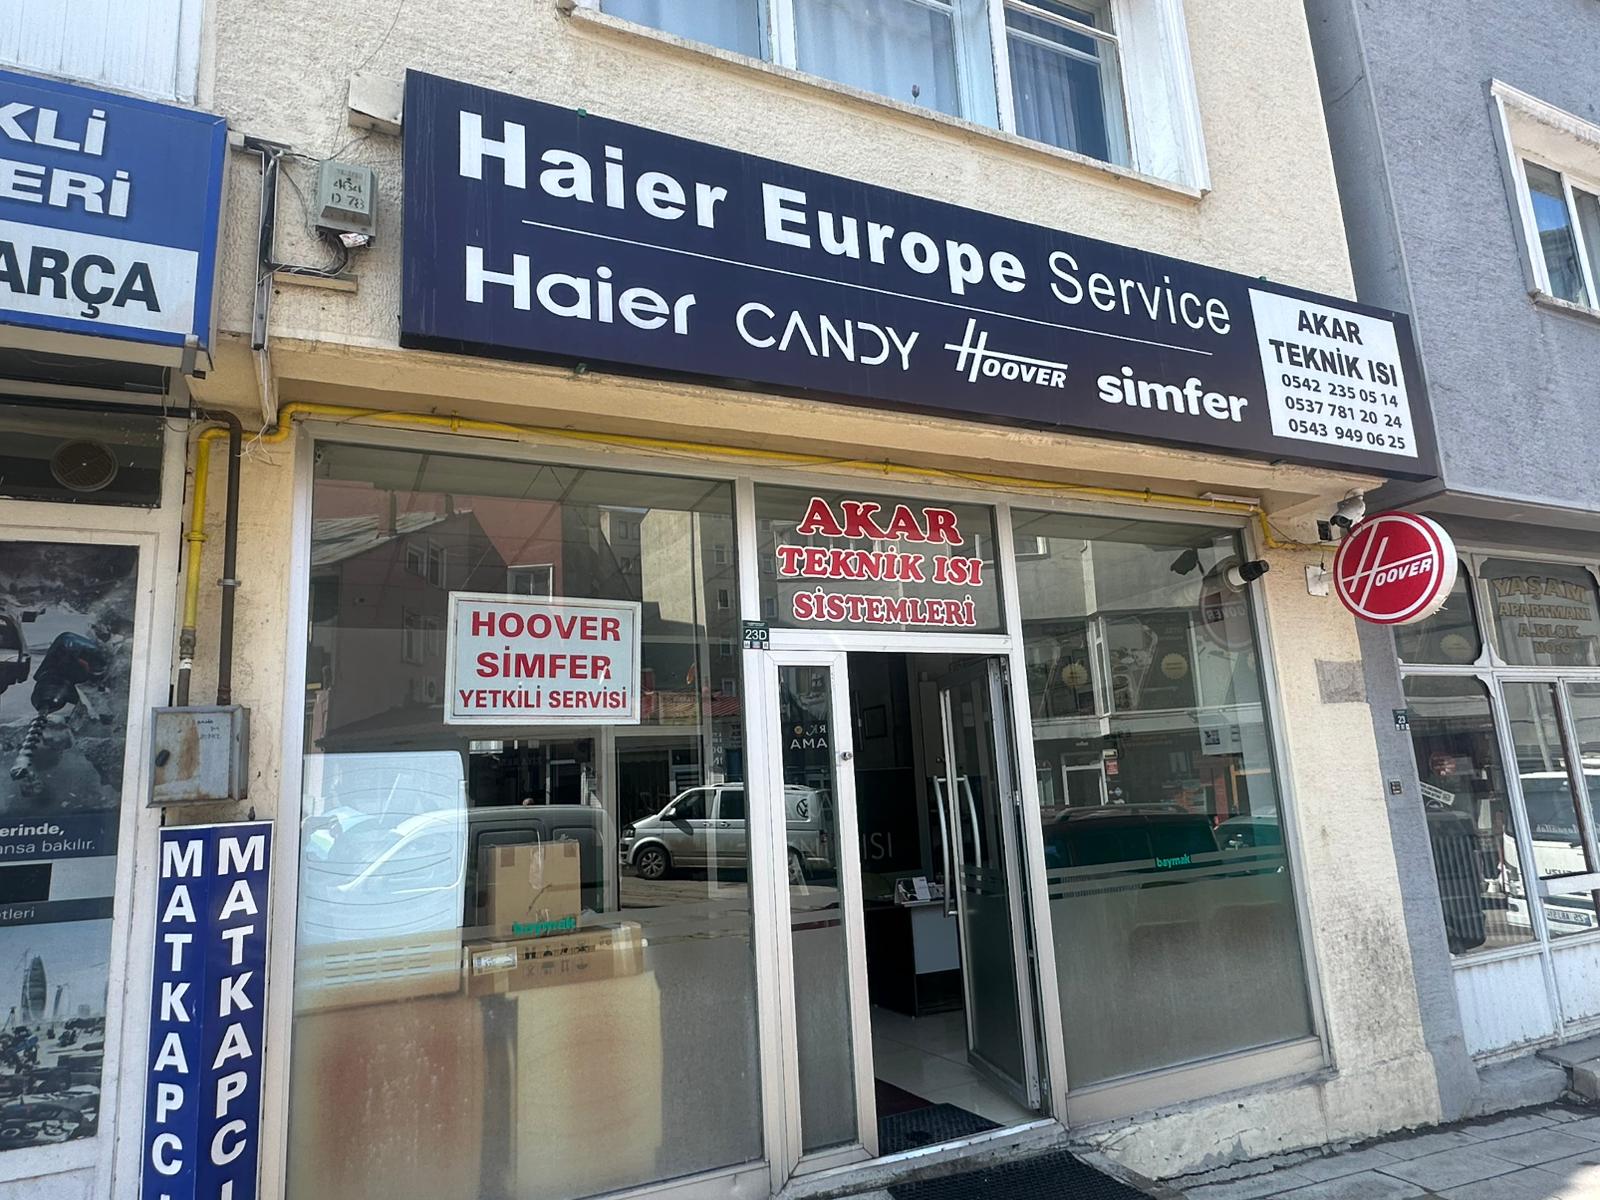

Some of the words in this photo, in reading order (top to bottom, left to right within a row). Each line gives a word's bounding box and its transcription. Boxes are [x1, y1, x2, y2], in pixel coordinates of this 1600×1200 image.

[459, 110, 728, 229] Haier
[762, 182, 1026, 295] Europe
[1048, 250, 1231, 335] Service
[465, 245, 696, 335] Haier
[736, 302, 919, 370] CANDY
[1298, 310, 1363, 345] AKAR
[1268, 338, 1364, 380] TEKNİK
[1368, 360, 1398, 387] ISI
[1097, 366, 1248, 423] simfer
[1282, 374, 1321, 393] 0542
[1328, 383, 1356, 400] 235
[1360, 389, 1377, 404] 05
[1381, 393, 1399, 408] 14
[1285, 396, 1323, 414] 0537
[1328, 403, 1355, 420] 781
[1360, 410, 1378, 424] 20
[1384, 414, 1402, 429] 24
[1289, 419, 1328, 437] 0543
[1335, 426, 1363, 442] 949
[1367, 432, 1385, 446] 06
[1388, 435, 1406, 449] 25
[797, 497, 964, 545] AKAR
[777, 545, 925, 584] TEKNİK
[932, 556, 983, 586] ISI
[794, 586, 976, 627] SİSTEMLERİ
[1492, 576, 1587, 603] YAŞAM
[471, 611, 621, 641] HOOVER
[745, 628, 767, 640] 23D
[476, 646, 612, 680] SİMFER
[459, 685, 541, 709] YETKİLİ
[549, 686, 627, 709] SERVİSİ
[0, 823, 65, 837] erinde,
[42, 838, 96, 852] bakılır.
[1157, 854, 1190, 868] baymak
[0, 907, 35, 920] tleri
[152, 840, 203, 1200] MATKAPC
